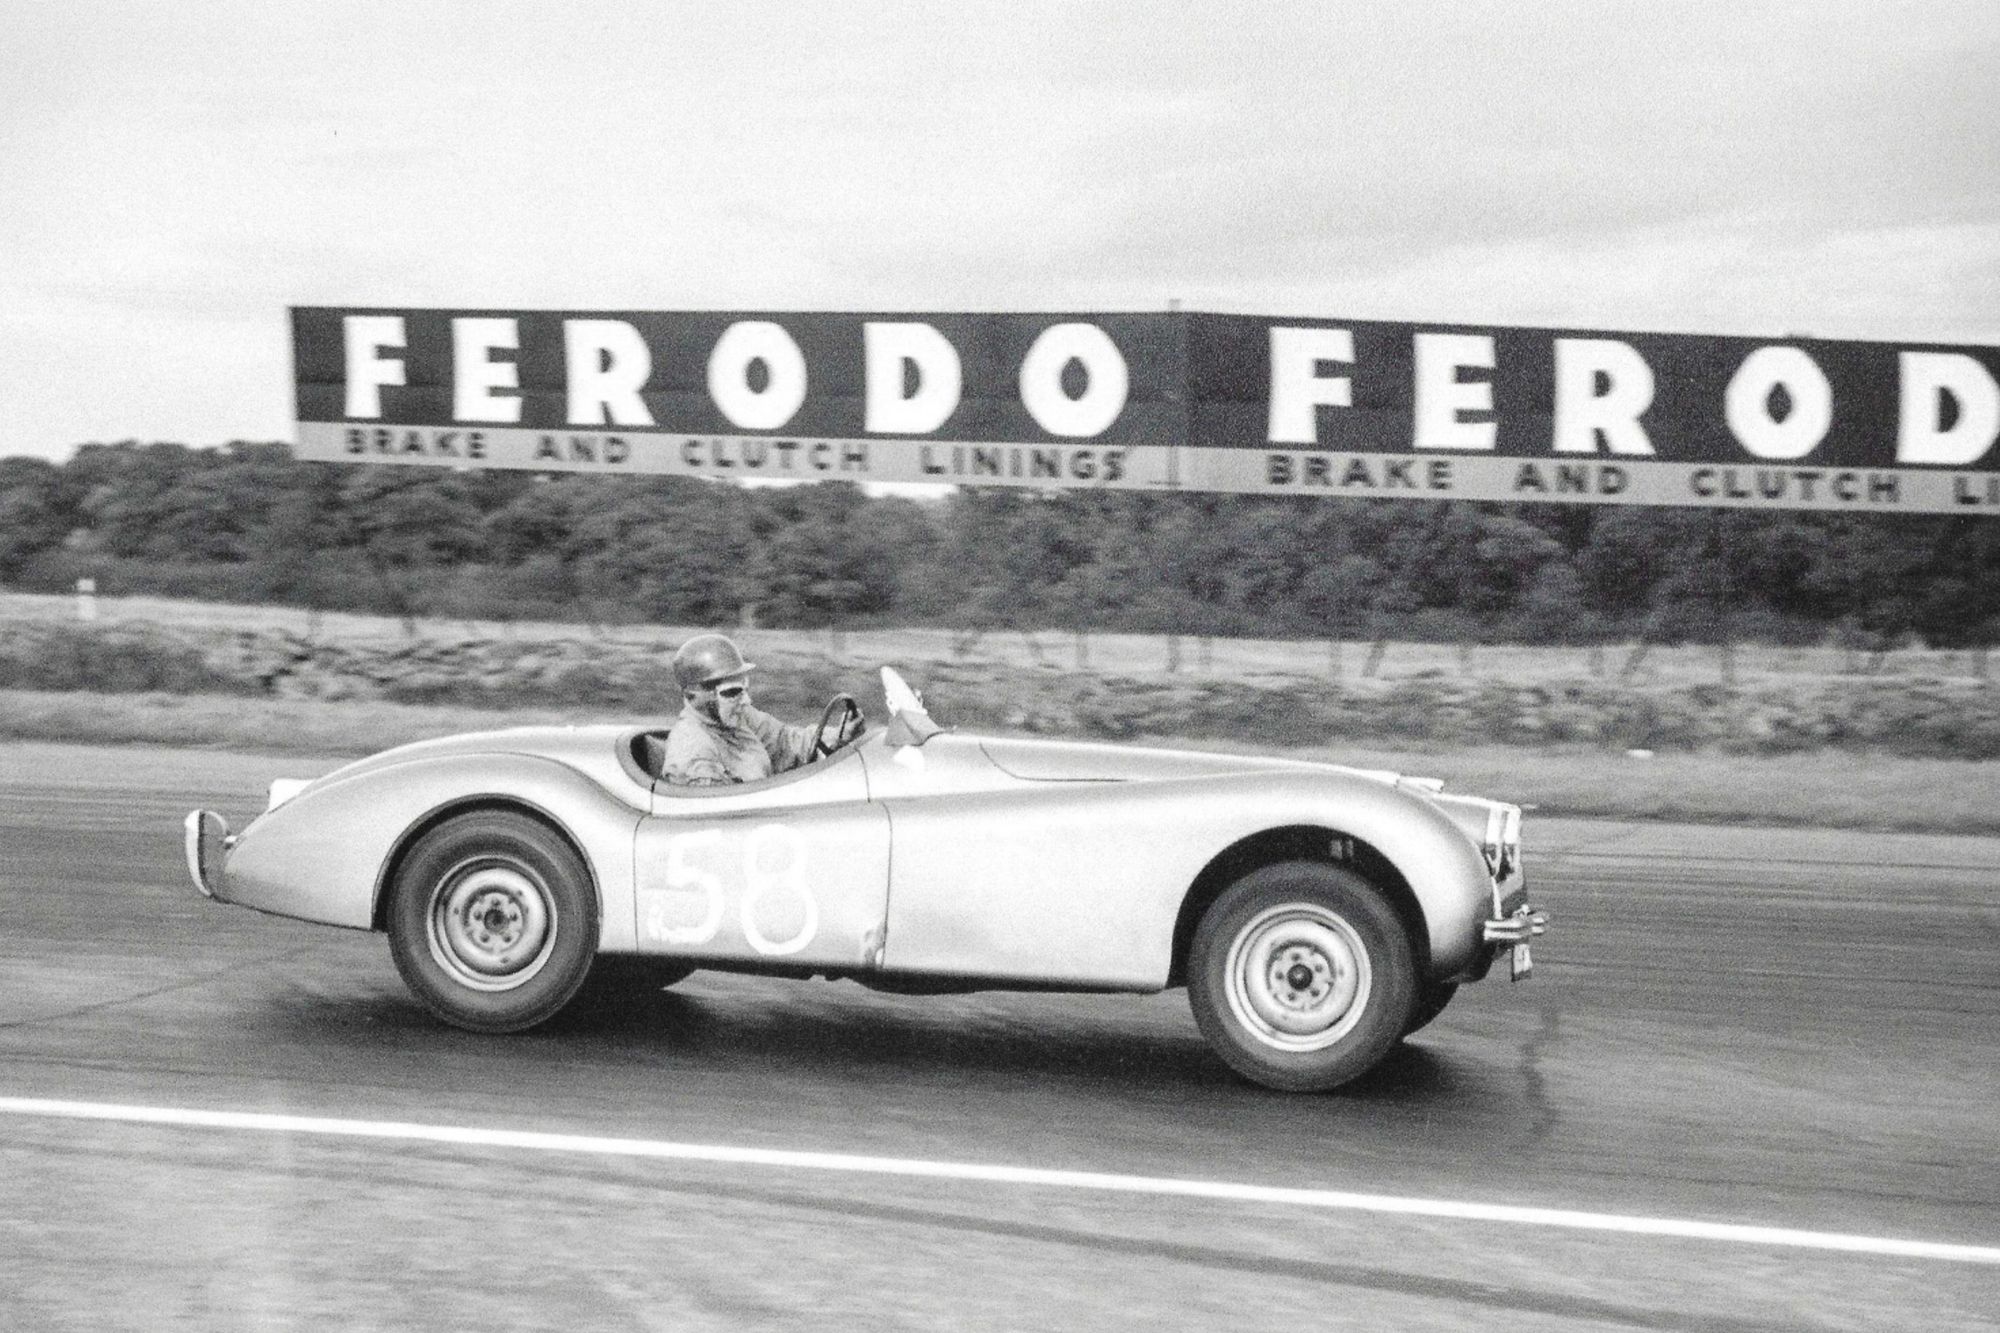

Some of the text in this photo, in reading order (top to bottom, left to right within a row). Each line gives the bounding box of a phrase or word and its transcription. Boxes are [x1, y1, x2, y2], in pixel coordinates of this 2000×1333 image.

[343, 316, 1129, 437] FERODO
[1267, 326, 2000, 464] FEROD
[345, 428, 1126, 481] BRAKE AND CLUTCH LININGS
[1265, 453, 1455, 491] BRAKE
[1513, 462, 1630, 496] AND
[1690, 468, 1900, 502] CLUTCH
[646, 823, 818, 955] 58
